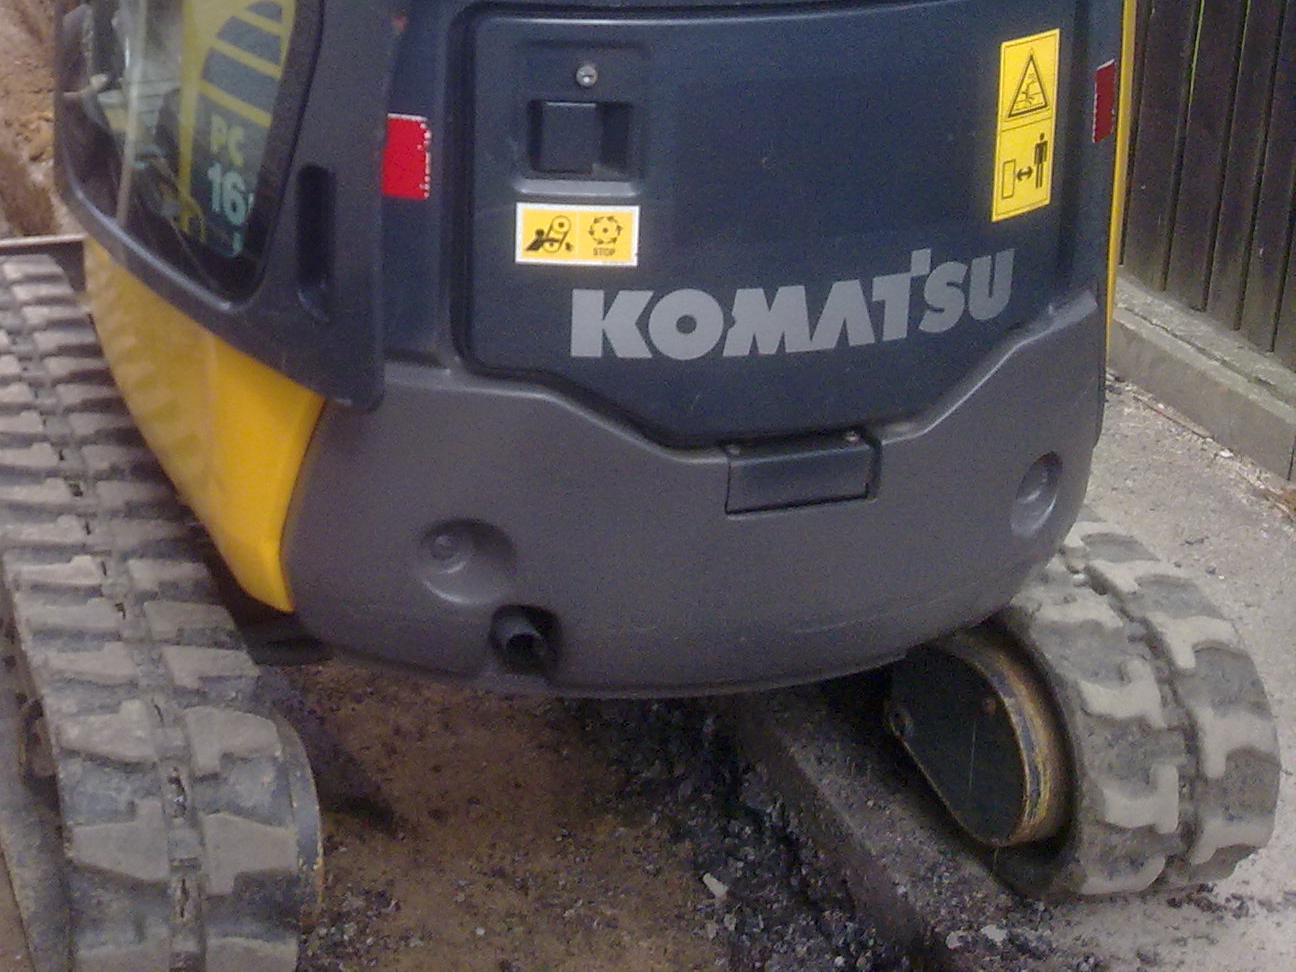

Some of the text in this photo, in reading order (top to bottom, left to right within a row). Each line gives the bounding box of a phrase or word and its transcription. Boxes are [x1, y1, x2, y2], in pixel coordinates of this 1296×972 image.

[210, 114, 245, 167] PC
[208, 162, 254, 225] 16
[593, 248, 616, 257] STOP
[570, 248, 1015, 360] KOMATSU
